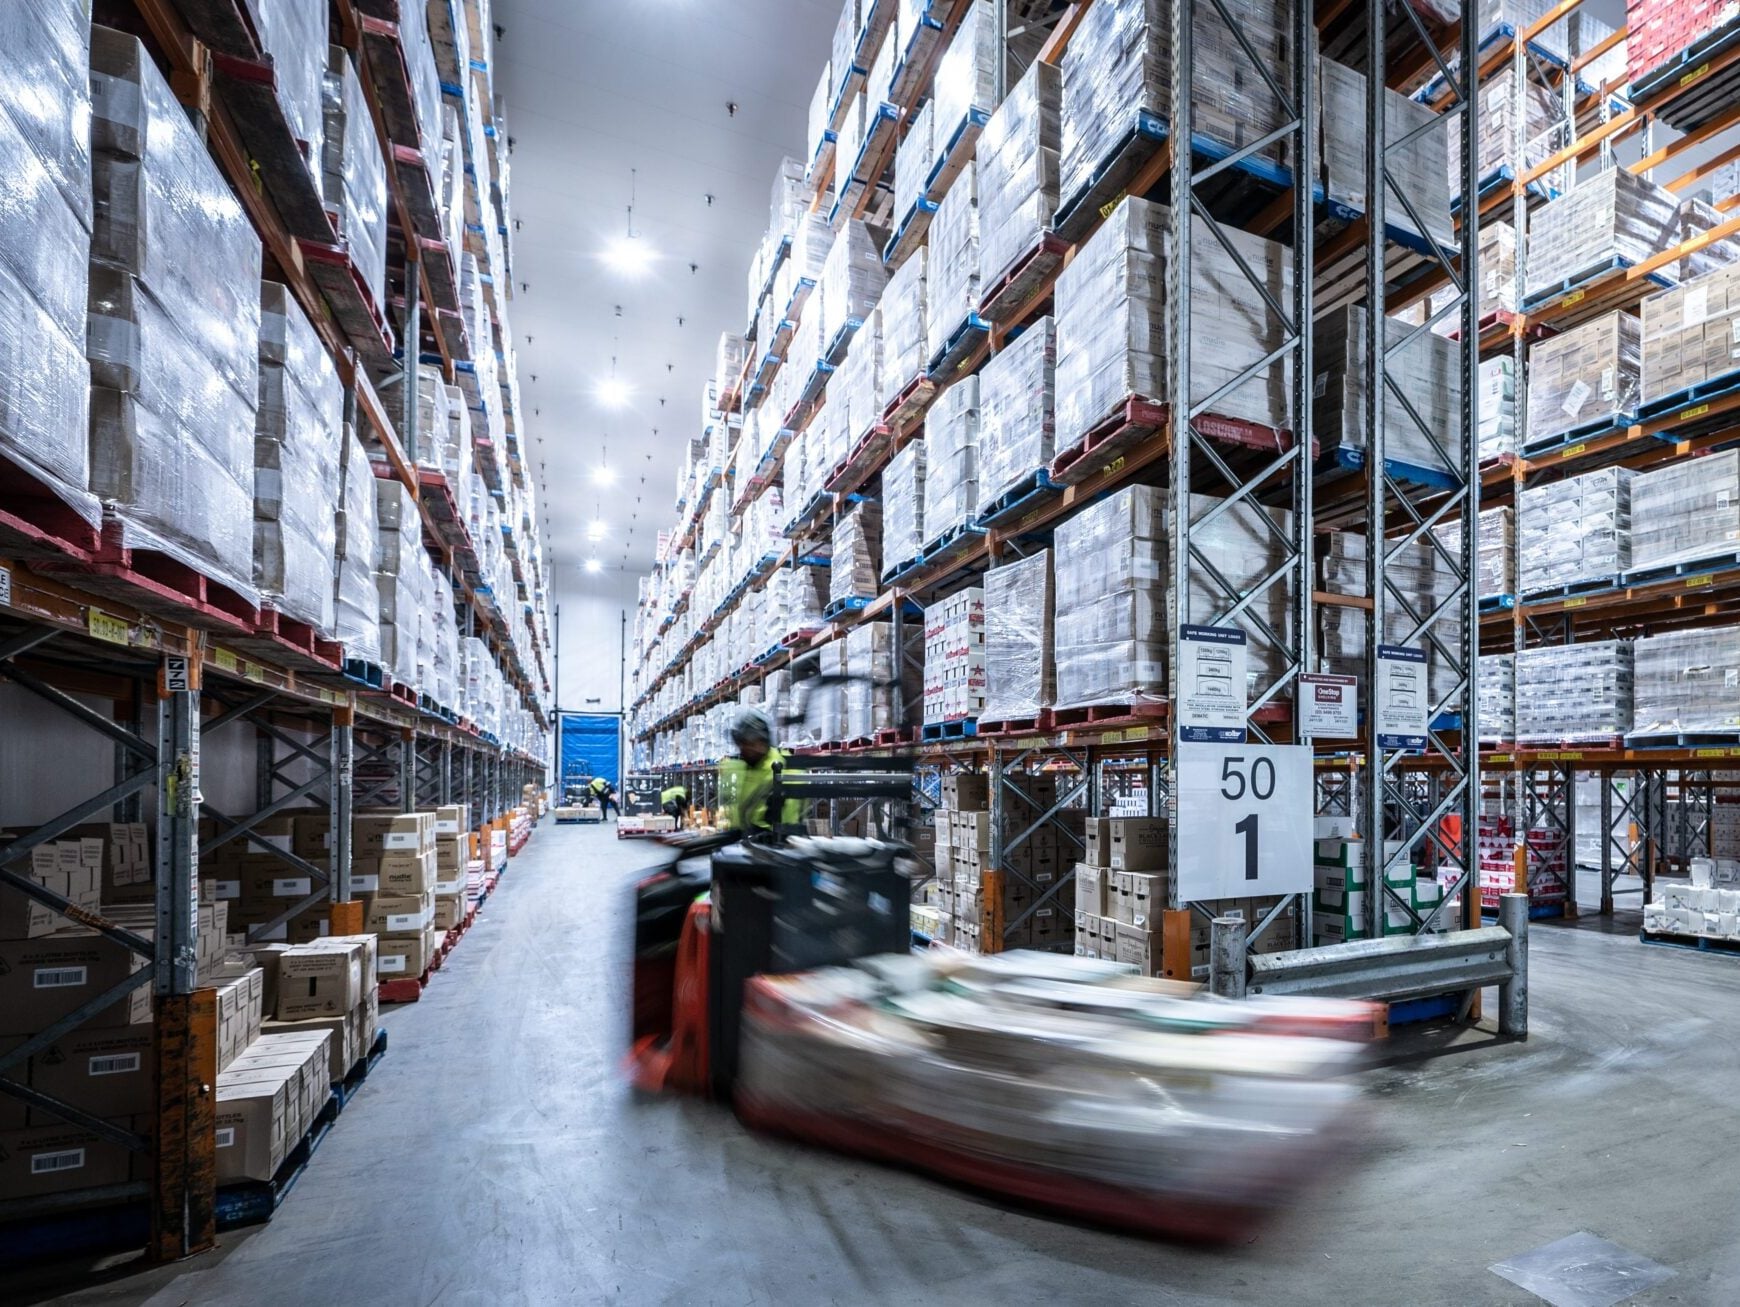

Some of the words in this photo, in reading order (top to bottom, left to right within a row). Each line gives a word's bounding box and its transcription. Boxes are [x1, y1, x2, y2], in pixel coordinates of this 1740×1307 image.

[1317, 687, 1340, 696] OneStop
[1221, 757, 1275, 800] 50
[1235, 814, 1258, 880] 1
